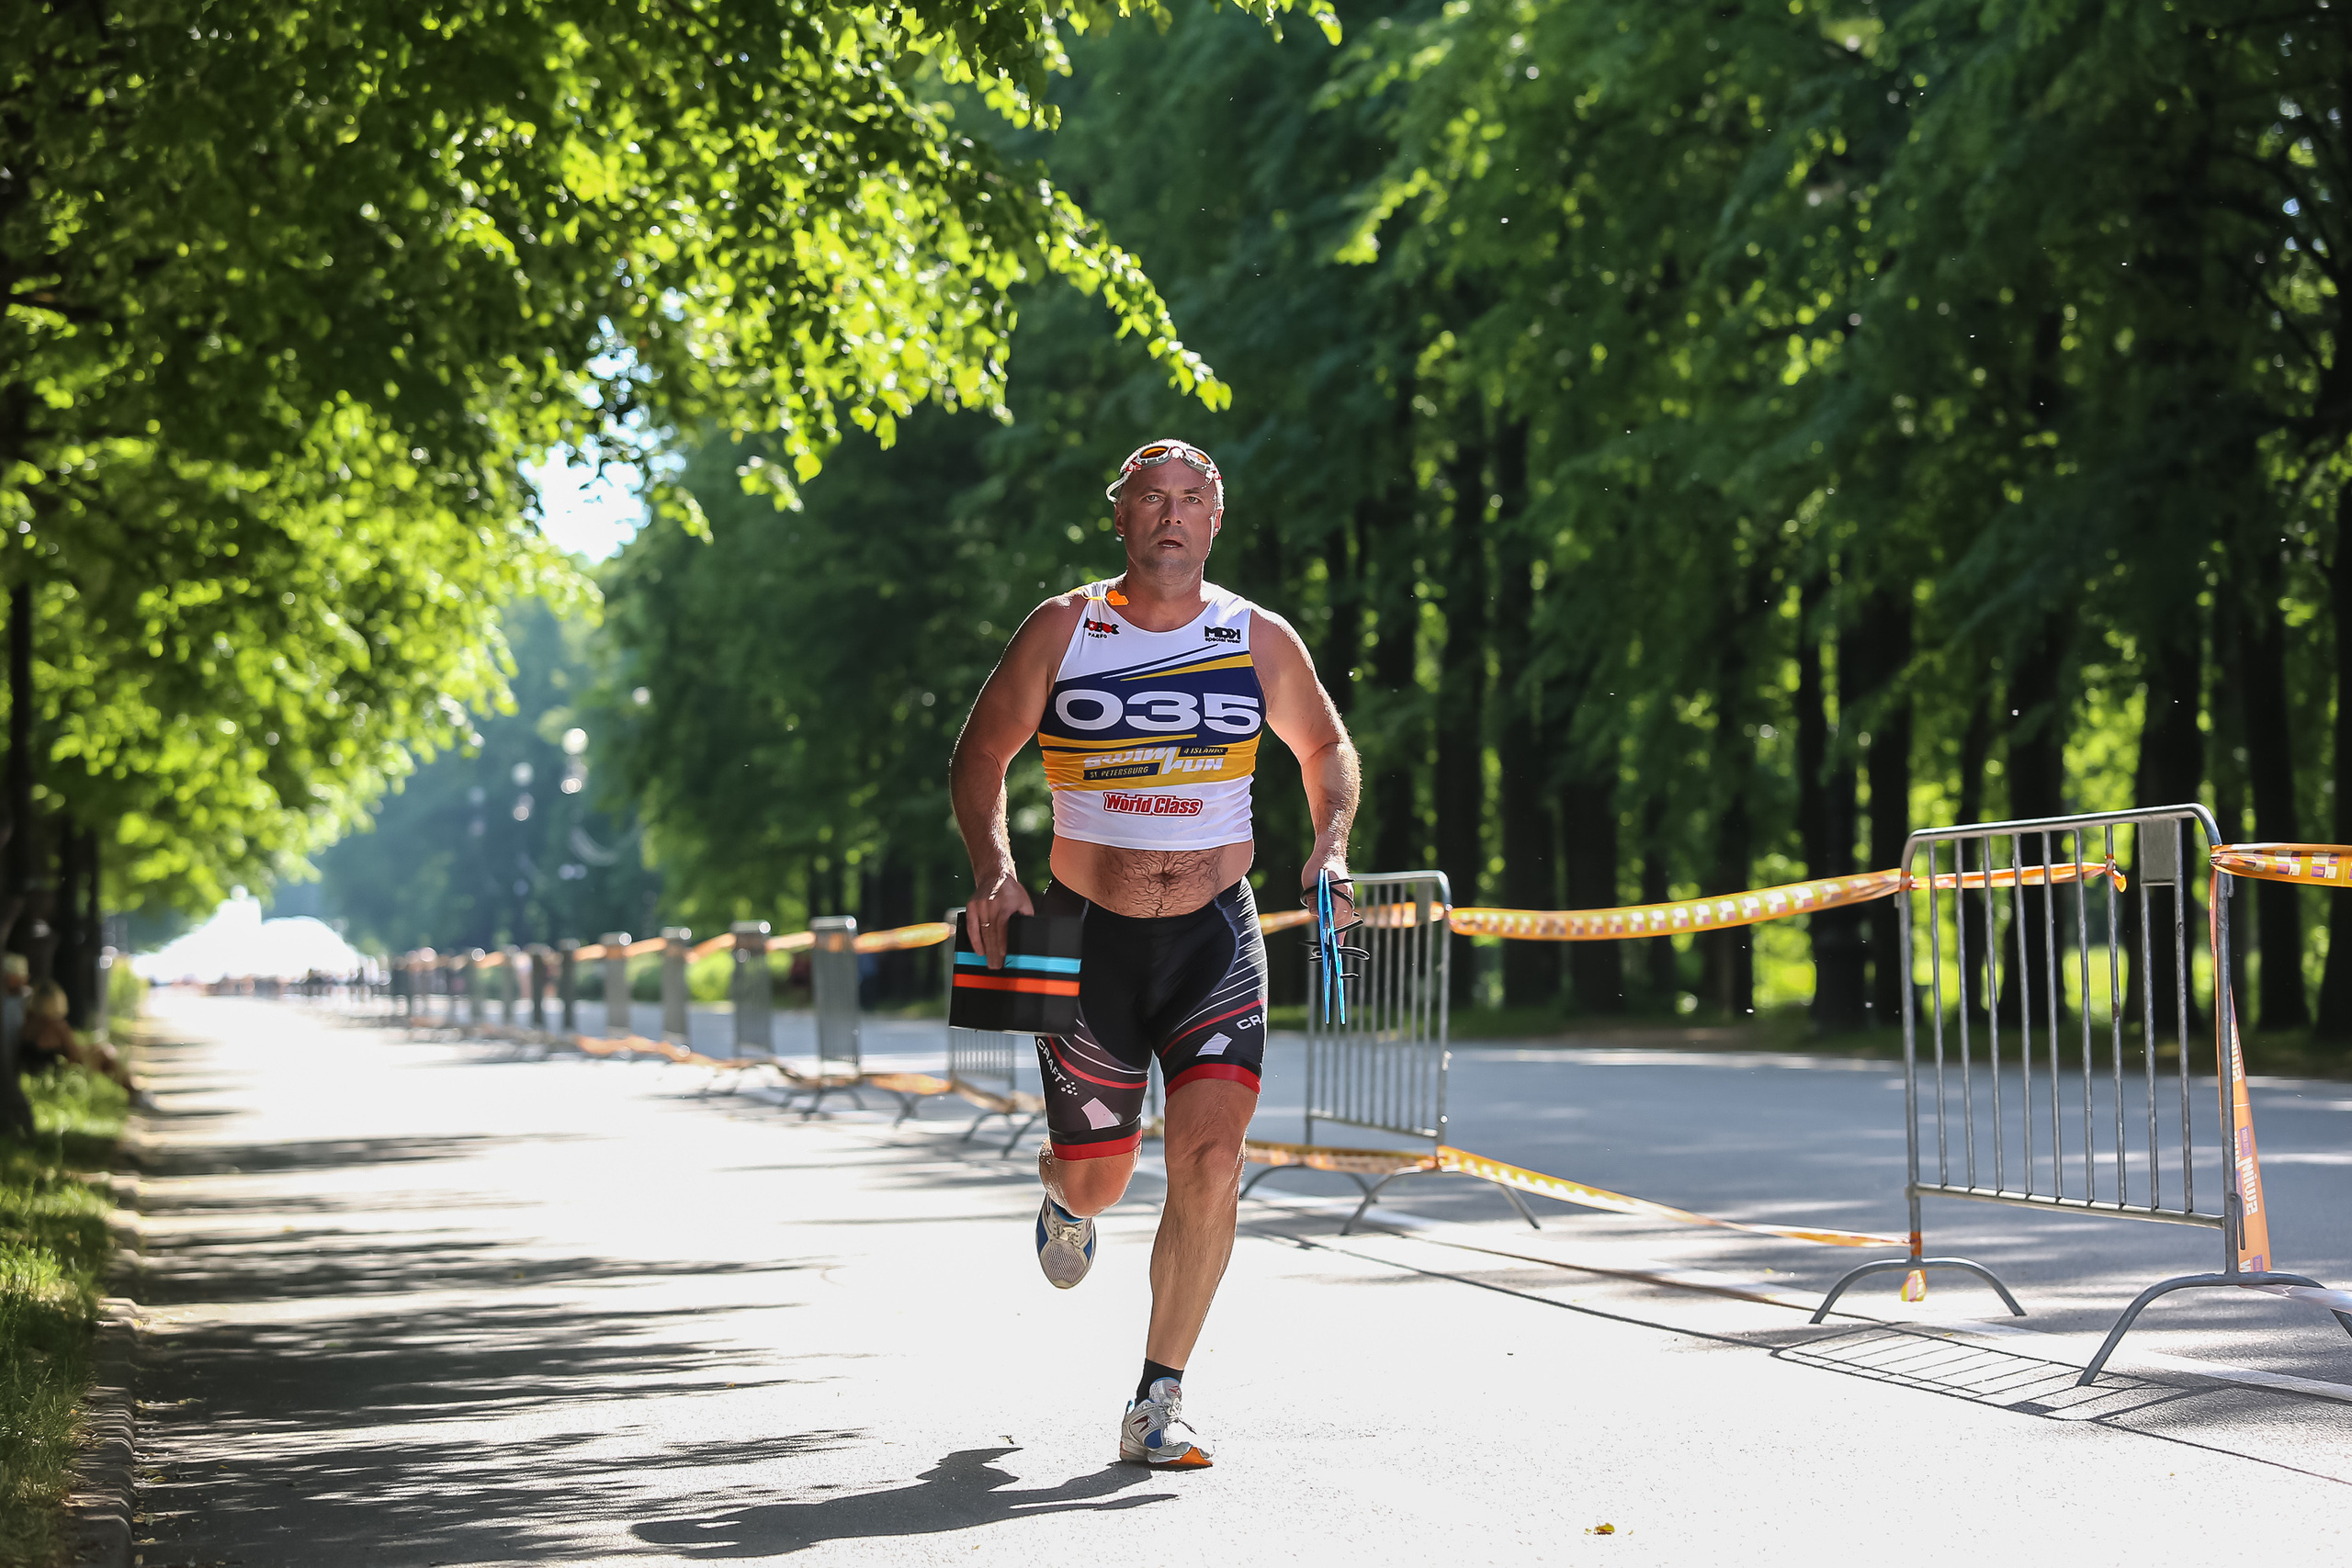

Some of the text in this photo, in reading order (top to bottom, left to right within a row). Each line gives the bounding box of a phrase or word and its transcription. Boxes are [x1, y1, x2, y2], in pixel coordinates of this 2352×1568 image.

[1056, 689, 1261, 735] 035
[1101, 766, 1148, 777] PETERSBURG
[1105, 794, 1200, 814] World Class
[1036, 1038, 1067, 1082] CRAFT
